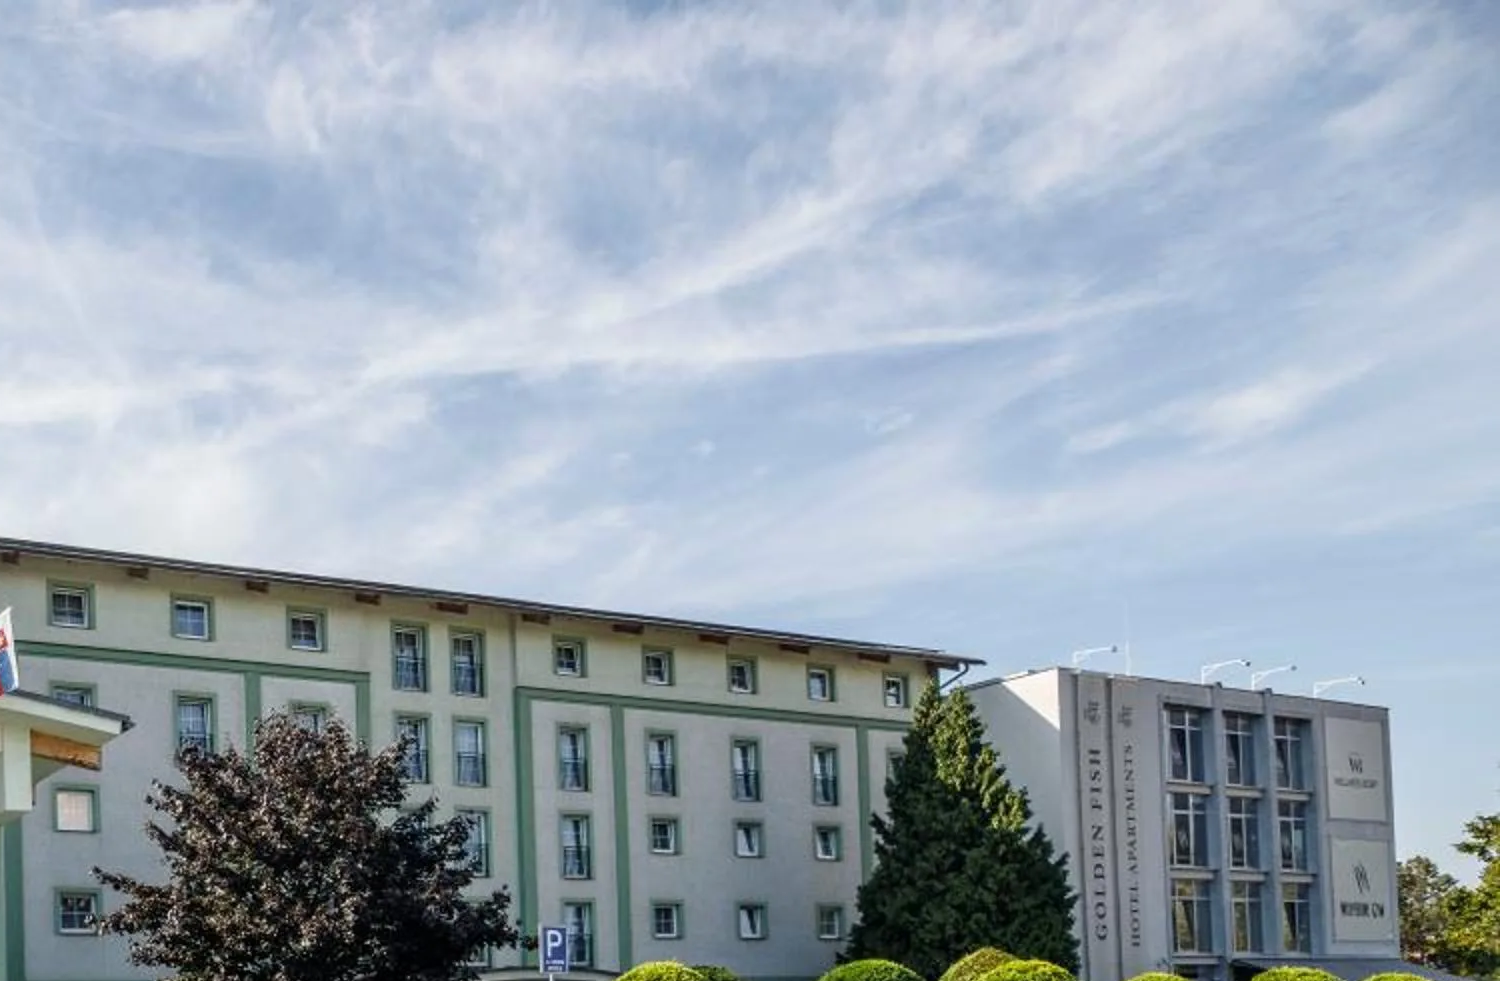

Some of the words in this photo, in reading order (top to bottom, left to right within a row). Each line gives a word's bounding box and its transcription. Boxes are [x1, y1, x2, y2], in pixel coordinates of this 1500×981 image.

[1088, 749, 1103, 810] FISH
[1124, 745, 1138, 873] APARTMENTS
[1091, 825, 1108, 941] GOLDEN
[547, 929, 562, 957] P
[1128, 884, 1141, 947] HOTEL
